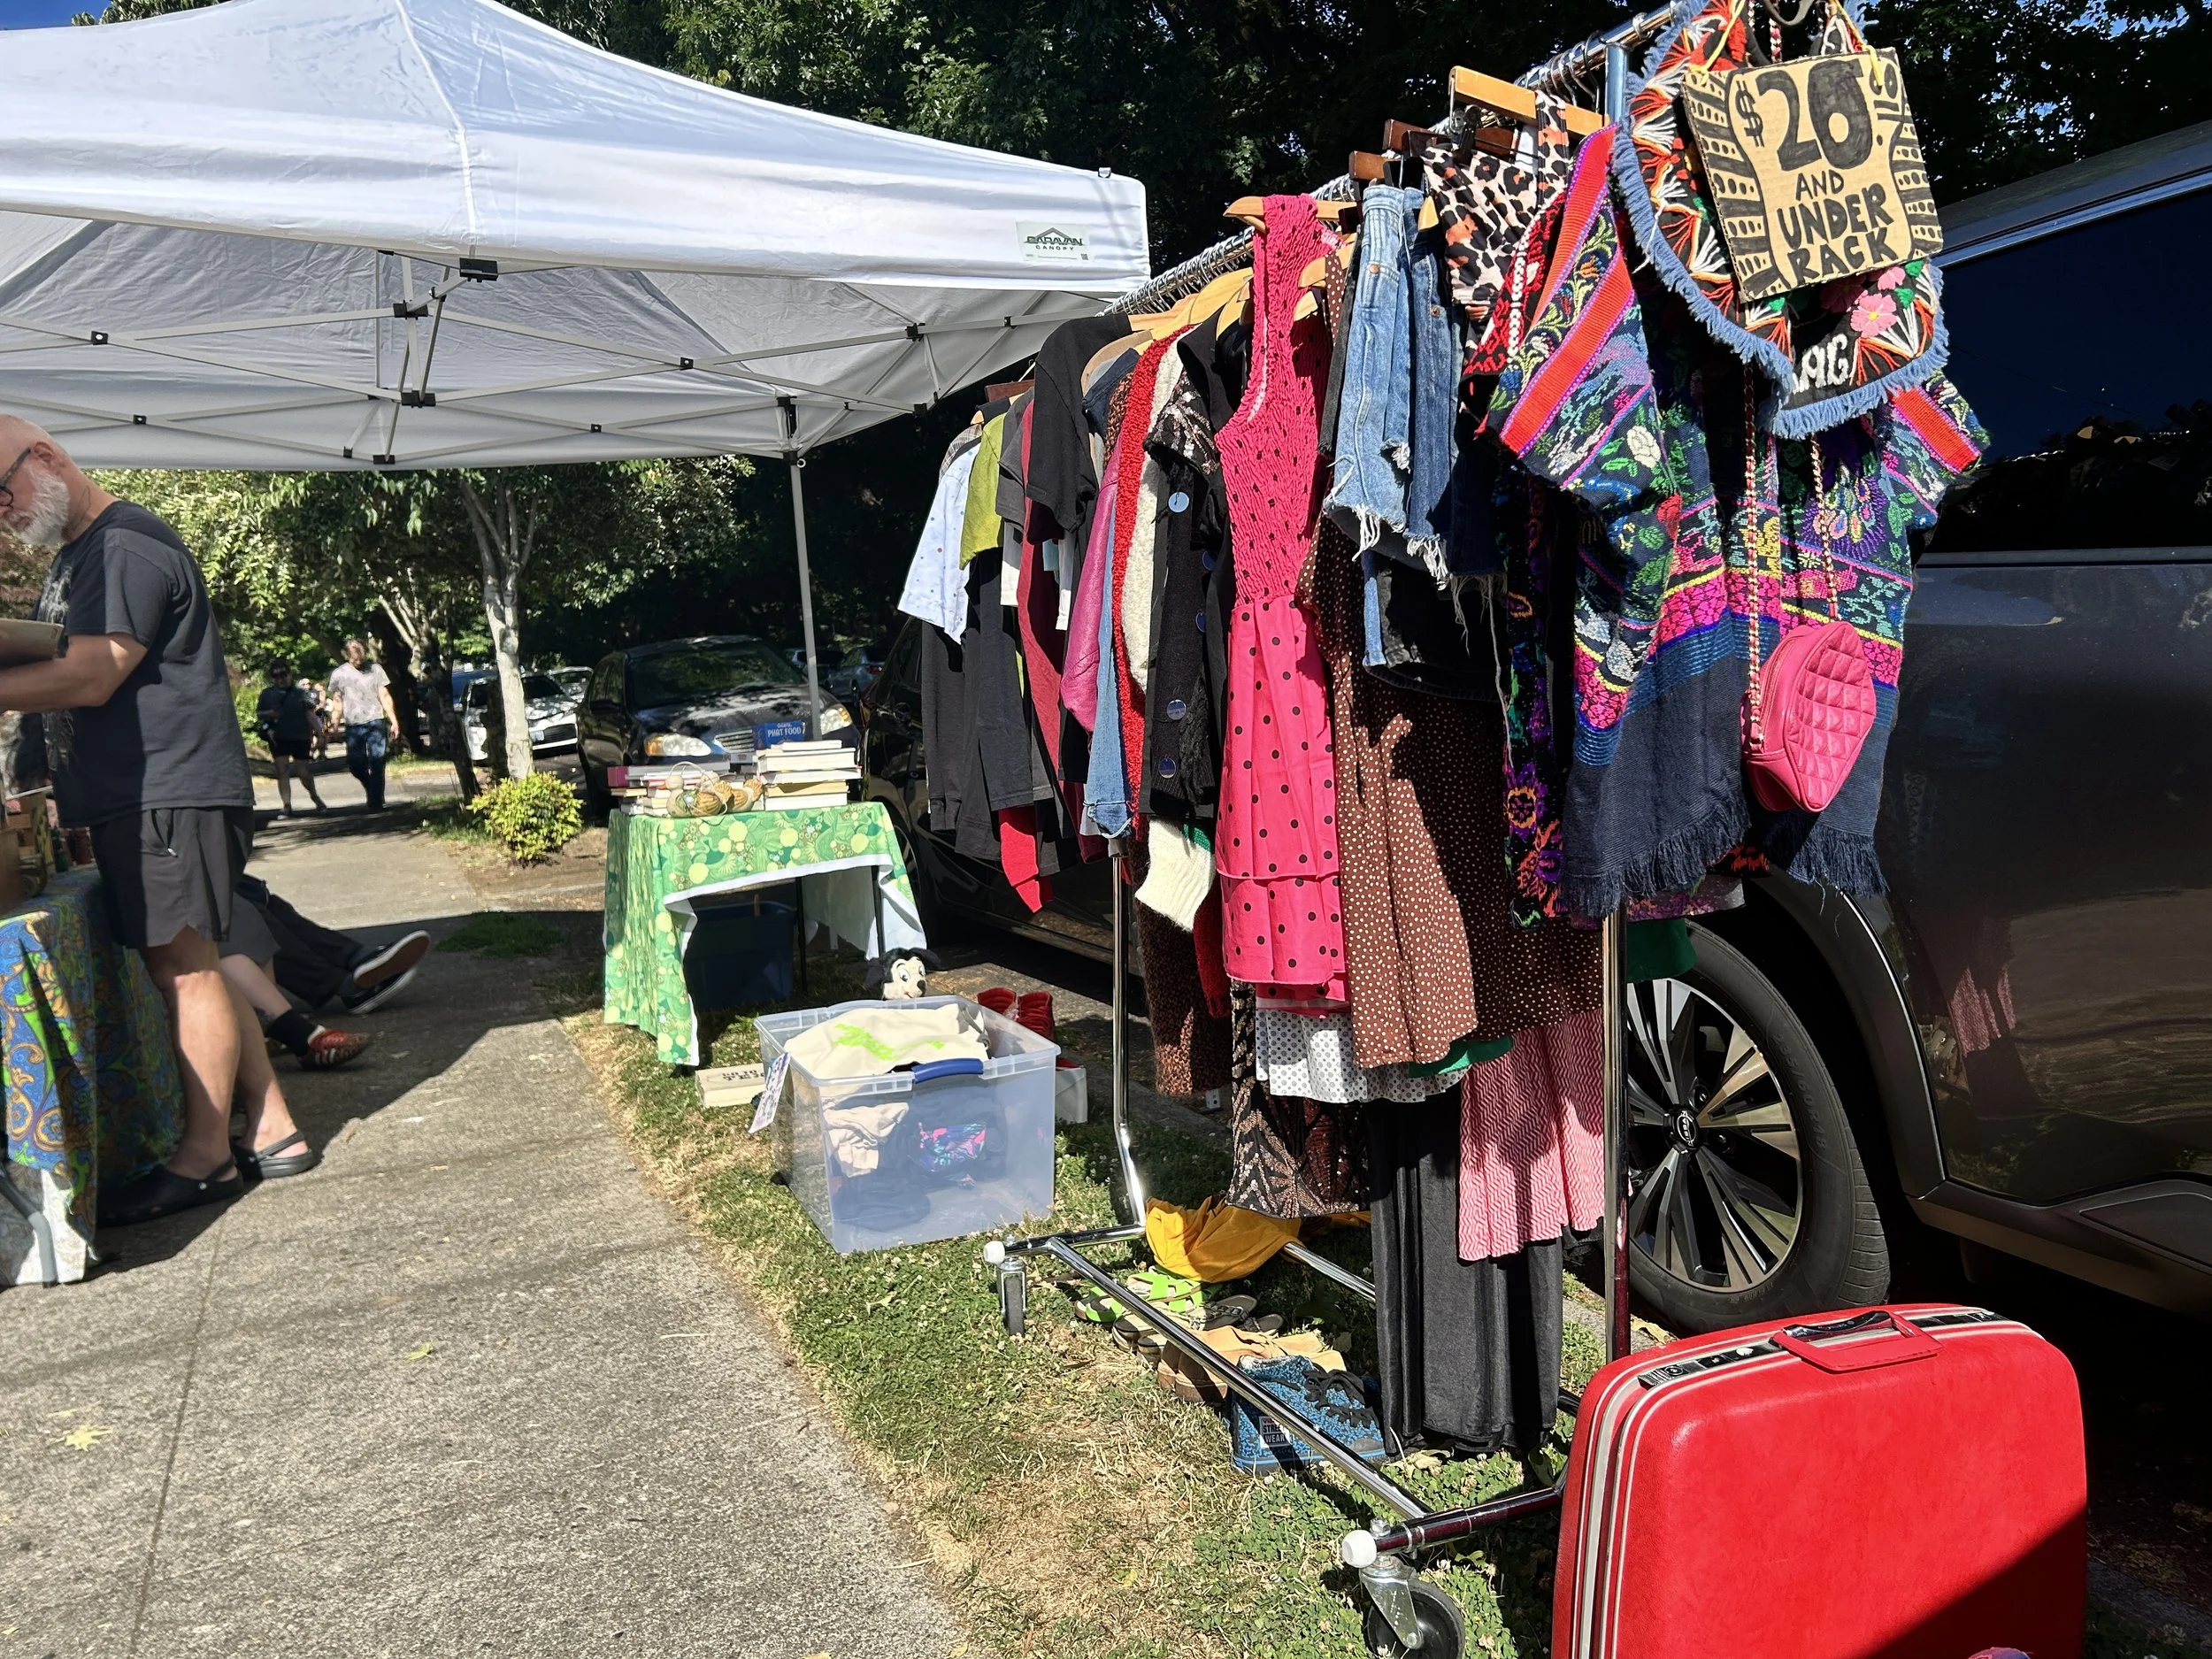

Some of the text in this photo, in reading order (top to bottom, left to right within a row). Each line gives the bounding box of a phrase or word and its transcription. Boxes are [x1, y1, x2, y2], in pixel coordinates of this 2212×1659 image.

[1795, 169, 1845, 202] AND
[1777, 182, 1894, 250] UNDER
[1025, 235, 1084, 246] CARAVAN
[1787, 227, 1899, 285] RACK
[767, 726, 802, 737] PHAT FOOD
[1264, 1433, 1286, 1443] WEAR
